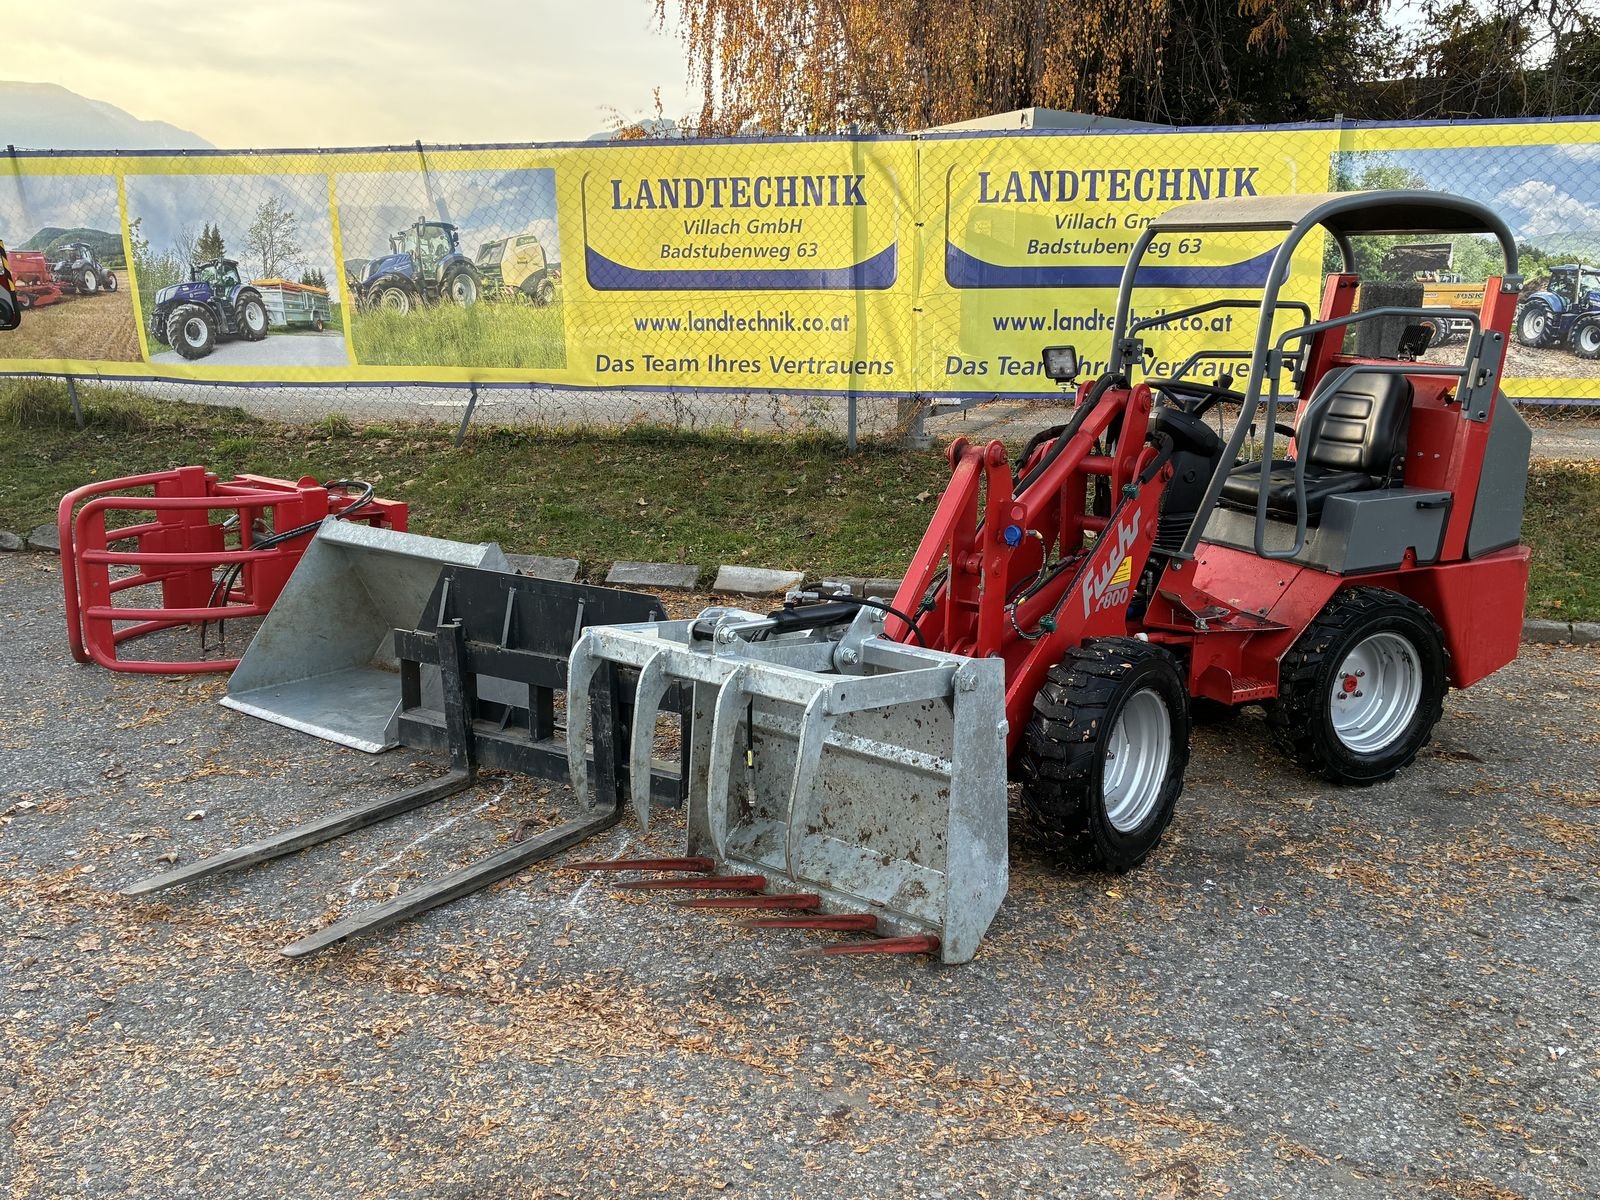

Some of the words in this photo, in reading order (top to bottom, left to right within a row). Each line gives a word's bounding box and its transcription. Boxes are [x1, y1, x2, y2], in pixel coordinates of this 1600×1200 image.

[611, 175, 867, 209] LANDTECHNIK
[977, 167, 1260, 203] LANDTECHNIK
[684, 219, 740, 236] Villach
[747, 218, 803, 235] GmbH
[1055, 213, 1116, 230] Villach
[1124, 212, 1164, 229] Gm
[660, 243, 791, 261] Badstubenweg
[796, 242, 819, 258] 63
[1026, 238, 1171, 258] Badstubeneg
[1178, 238, 1202, 254] 63
[634, 310, 850, 333] www.landtechnik.co.at
[993, 308, 1233, 333] www.landtehnik.co.at
[595, 354, 635, 373] Das
[642, 354, 700, 373] Team
[707, 354, 762, 373] Ihres
[770, 355, 895, 376] Vertrauens
[945, 355, 988, 375] Das
[1141, 356, 1250, 377] Verraue
